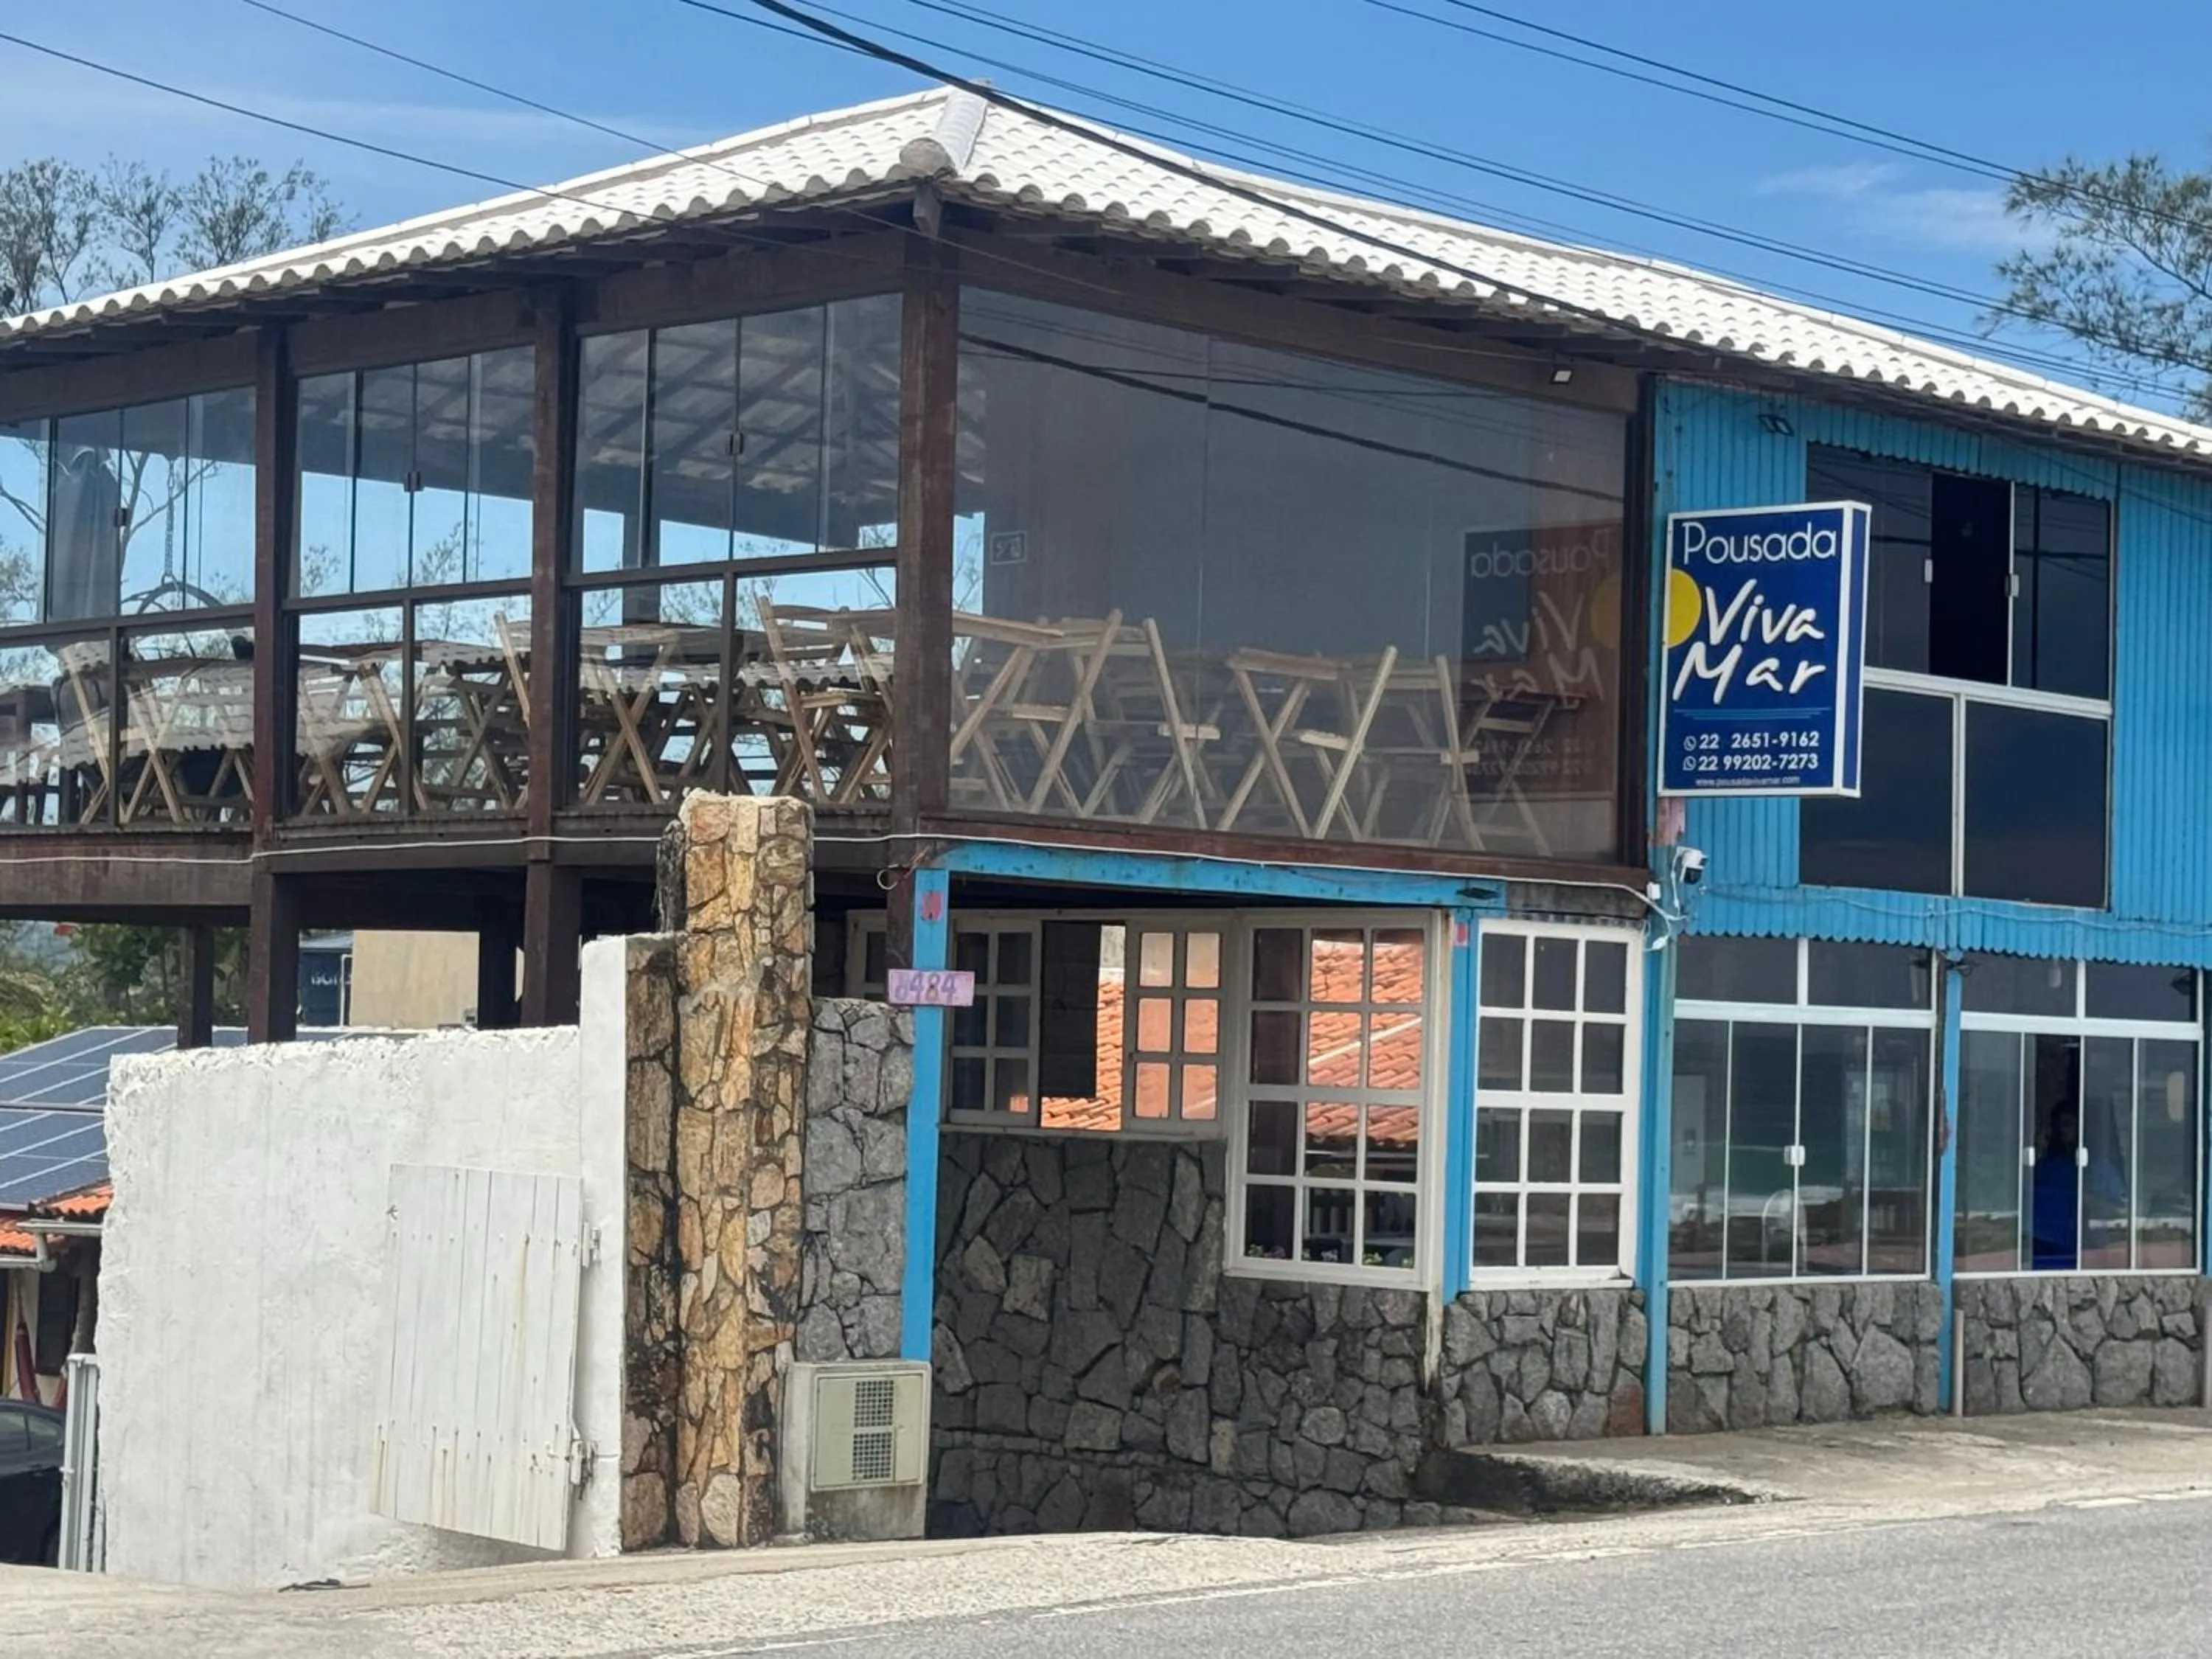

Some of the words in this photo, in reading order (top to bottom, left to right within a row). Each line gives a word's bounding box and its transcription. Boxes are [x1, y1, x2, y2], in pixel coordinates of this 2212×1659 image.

[1682, 521, 1837, 566] Pousada
[1705, 578, 1825, 646] Viva
[1672, 641, 1827, 705] Mar
[1697, 755, 1719, 771] 22
[1722, 753, 1819, 771] 99202-7273
[1698, 733, 1720, 749] 22
[1730, 731, 1820, 749] 2651-9162
